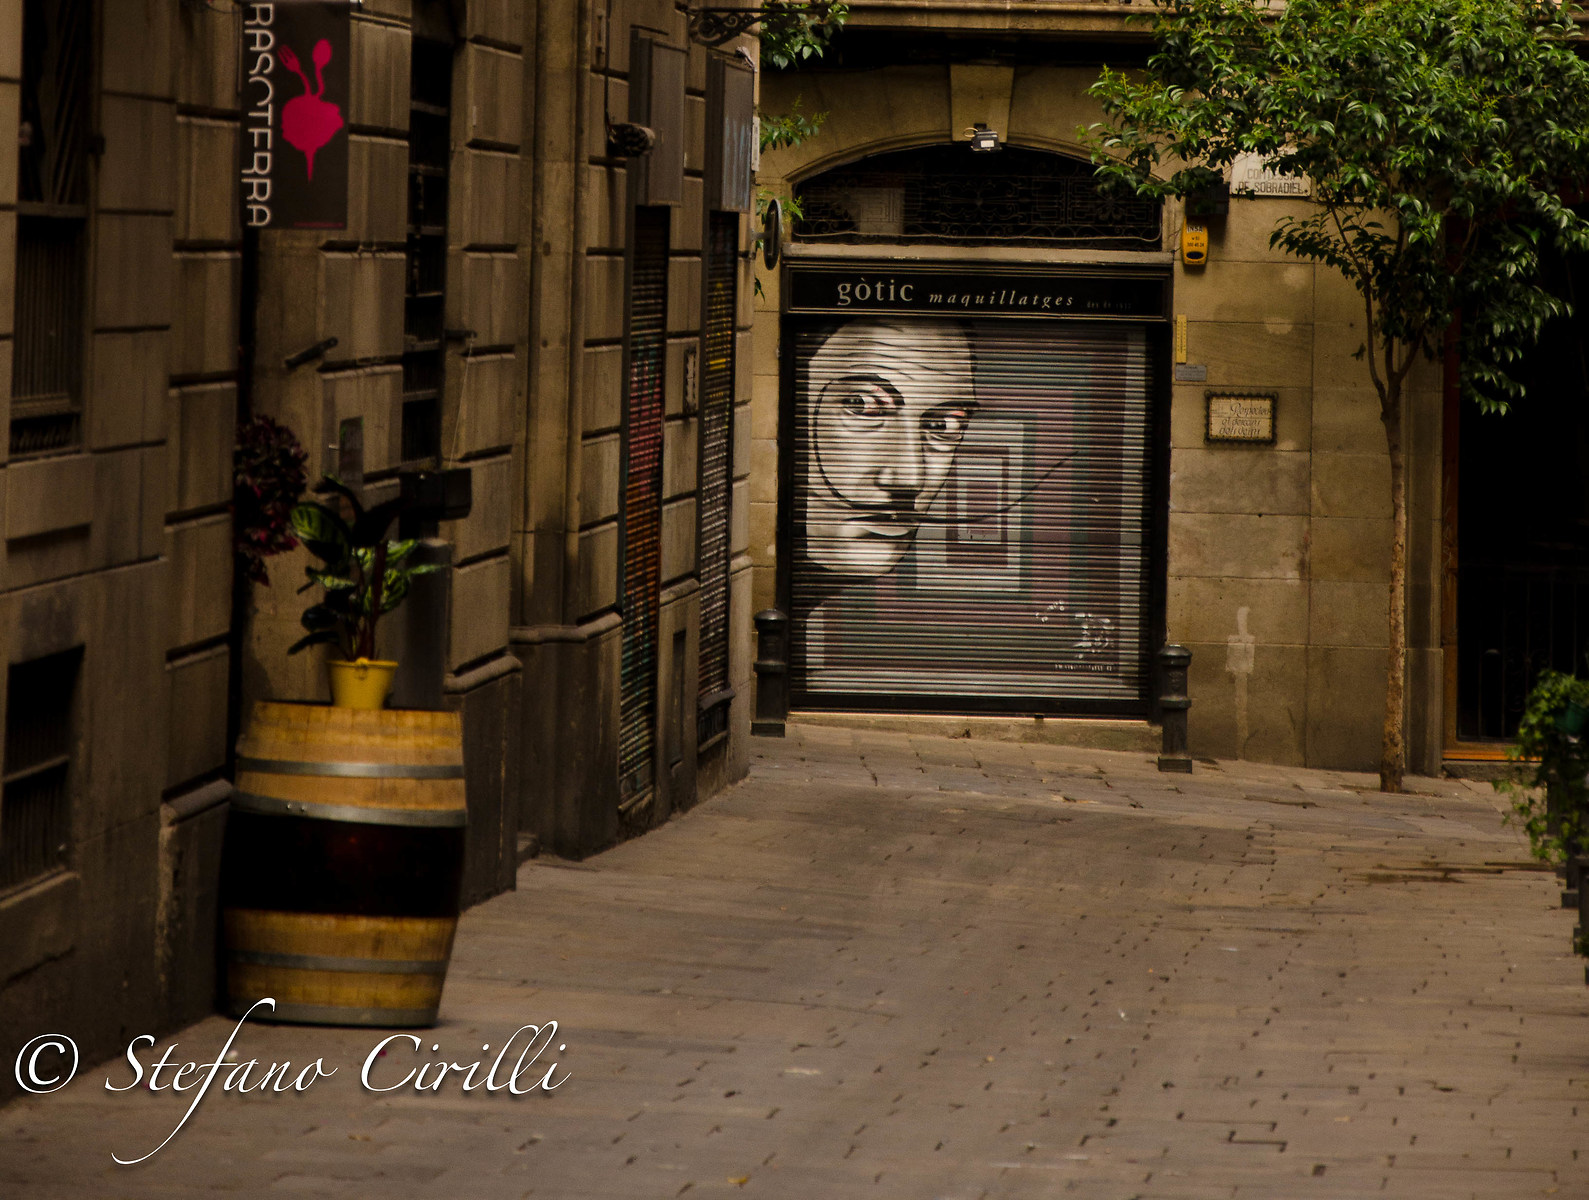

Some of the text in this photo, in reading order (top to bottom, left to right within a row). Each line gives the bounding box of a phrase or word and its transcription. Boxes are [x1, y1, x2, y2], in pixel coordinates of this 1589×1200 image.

[1254, 181, 1304, 194] SOBRADIEL
[837, 277, 914, 306] gòtic
[929, 290, 1074, 309] maquillatges
